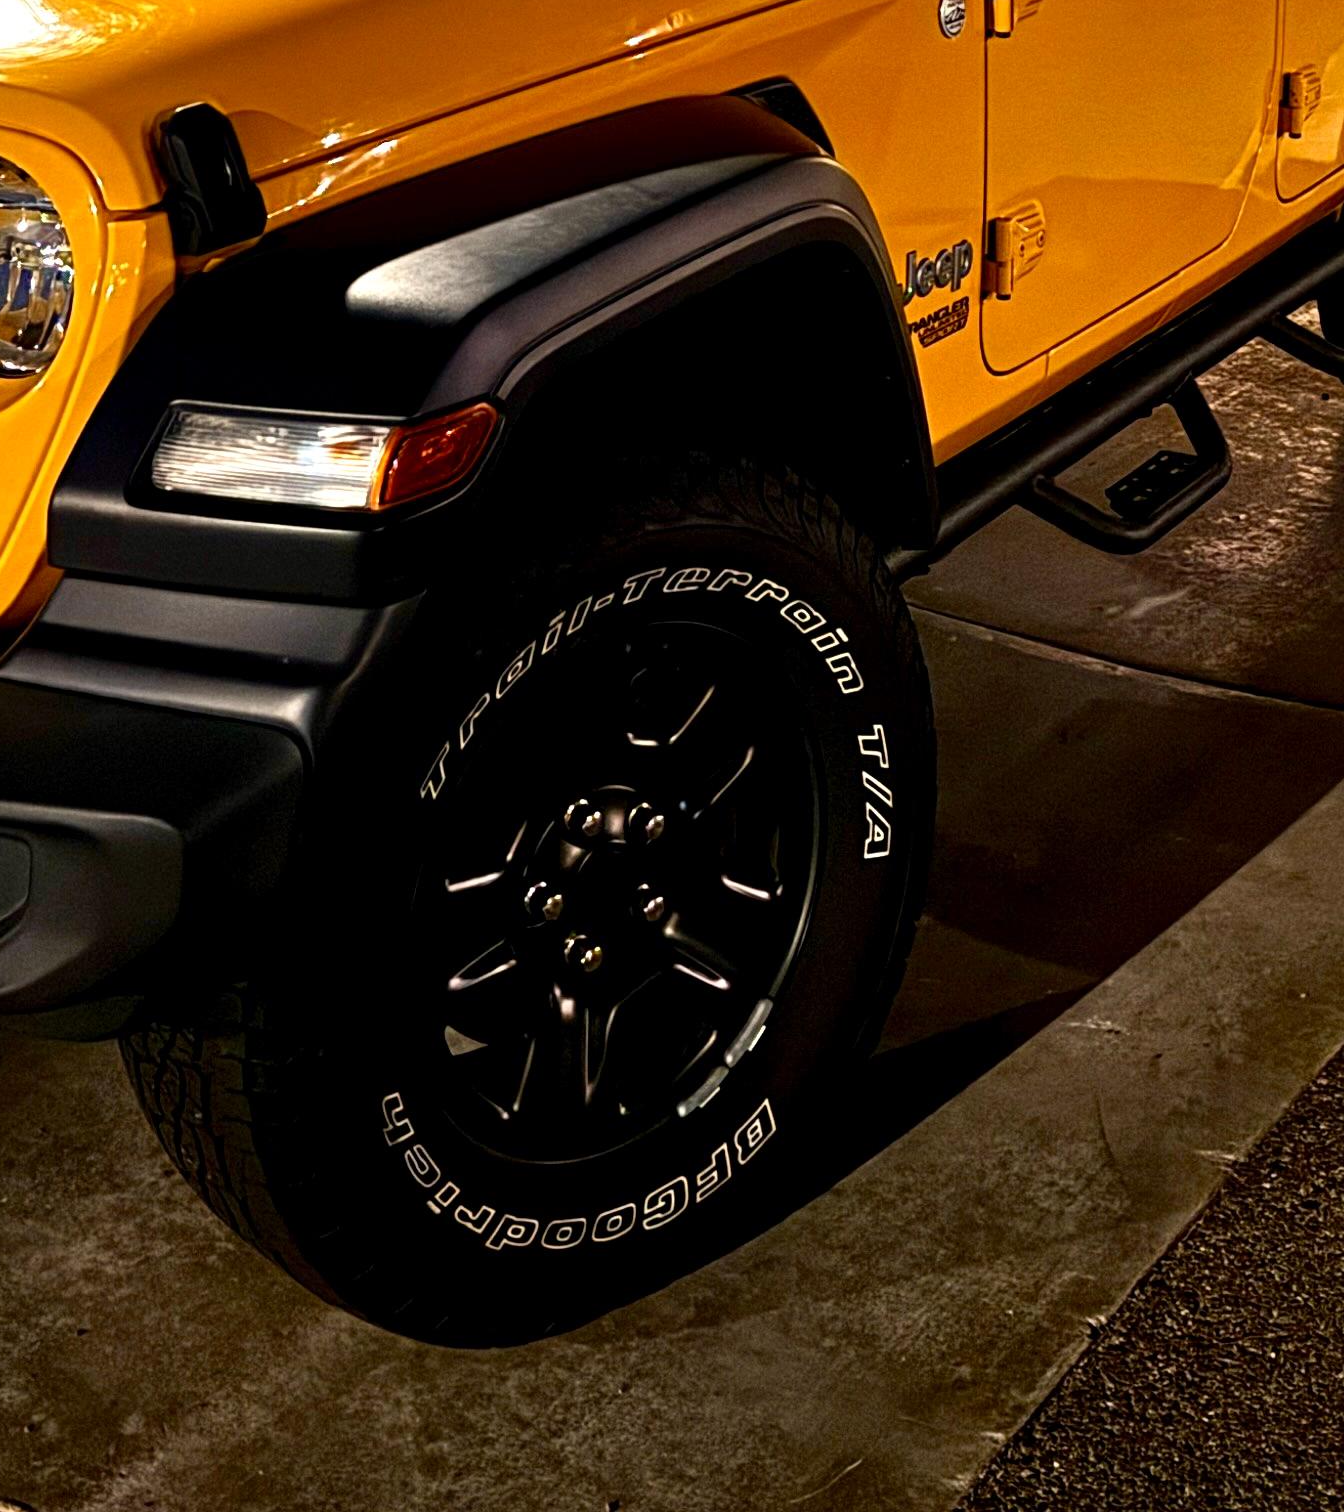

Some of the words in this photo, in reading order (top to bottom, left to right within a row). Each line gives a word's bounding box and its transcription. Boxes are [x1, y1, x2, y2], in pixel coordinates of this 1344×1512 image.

[904, 240, 973, 306] Jeep
[907, 296, 969, 333] RANGLER
[420, 566, 864, 800] Trail-Terrain
[857, 724, 892, 859] T/A
[382, 1093, 777, 1250] BFGoodrich
